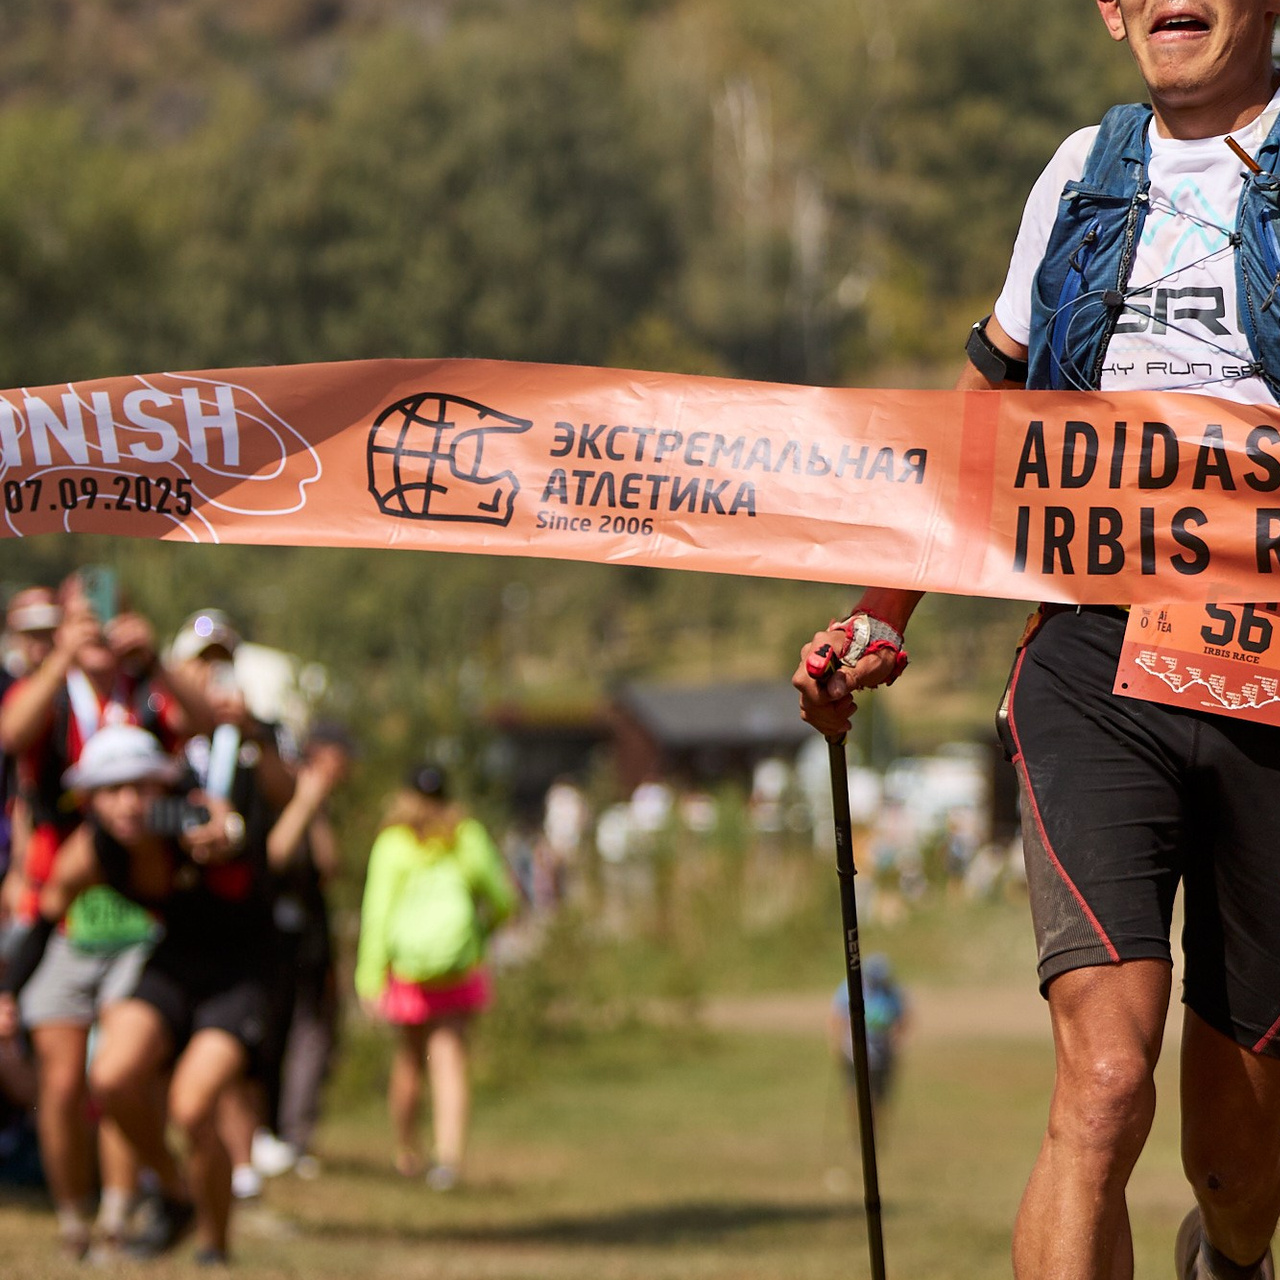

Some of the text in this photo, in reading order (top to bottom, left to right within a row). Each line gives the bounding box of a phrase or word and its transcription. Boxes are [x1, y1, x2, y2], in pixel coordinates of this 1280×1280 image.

[1112, 286, 1247, 336] SR
[1146, 362, 1212, 376] RUN
[549, 422, 928, 485] ЭКСТРЕМАЛЬНАЯ
[4, 475, 193, 516] 07.09.2025
[540, 468, 757, 517] АТЛЕТИКА
[536, 510, 654, 536] Since 2006
[1012, 506, 1210, 576] IRBIS
[1157, 621, 1172, 634] TEA
[1199, 602, 1278, 654] 56
[1203, 646, 1260, 664] IRBIS RACE
